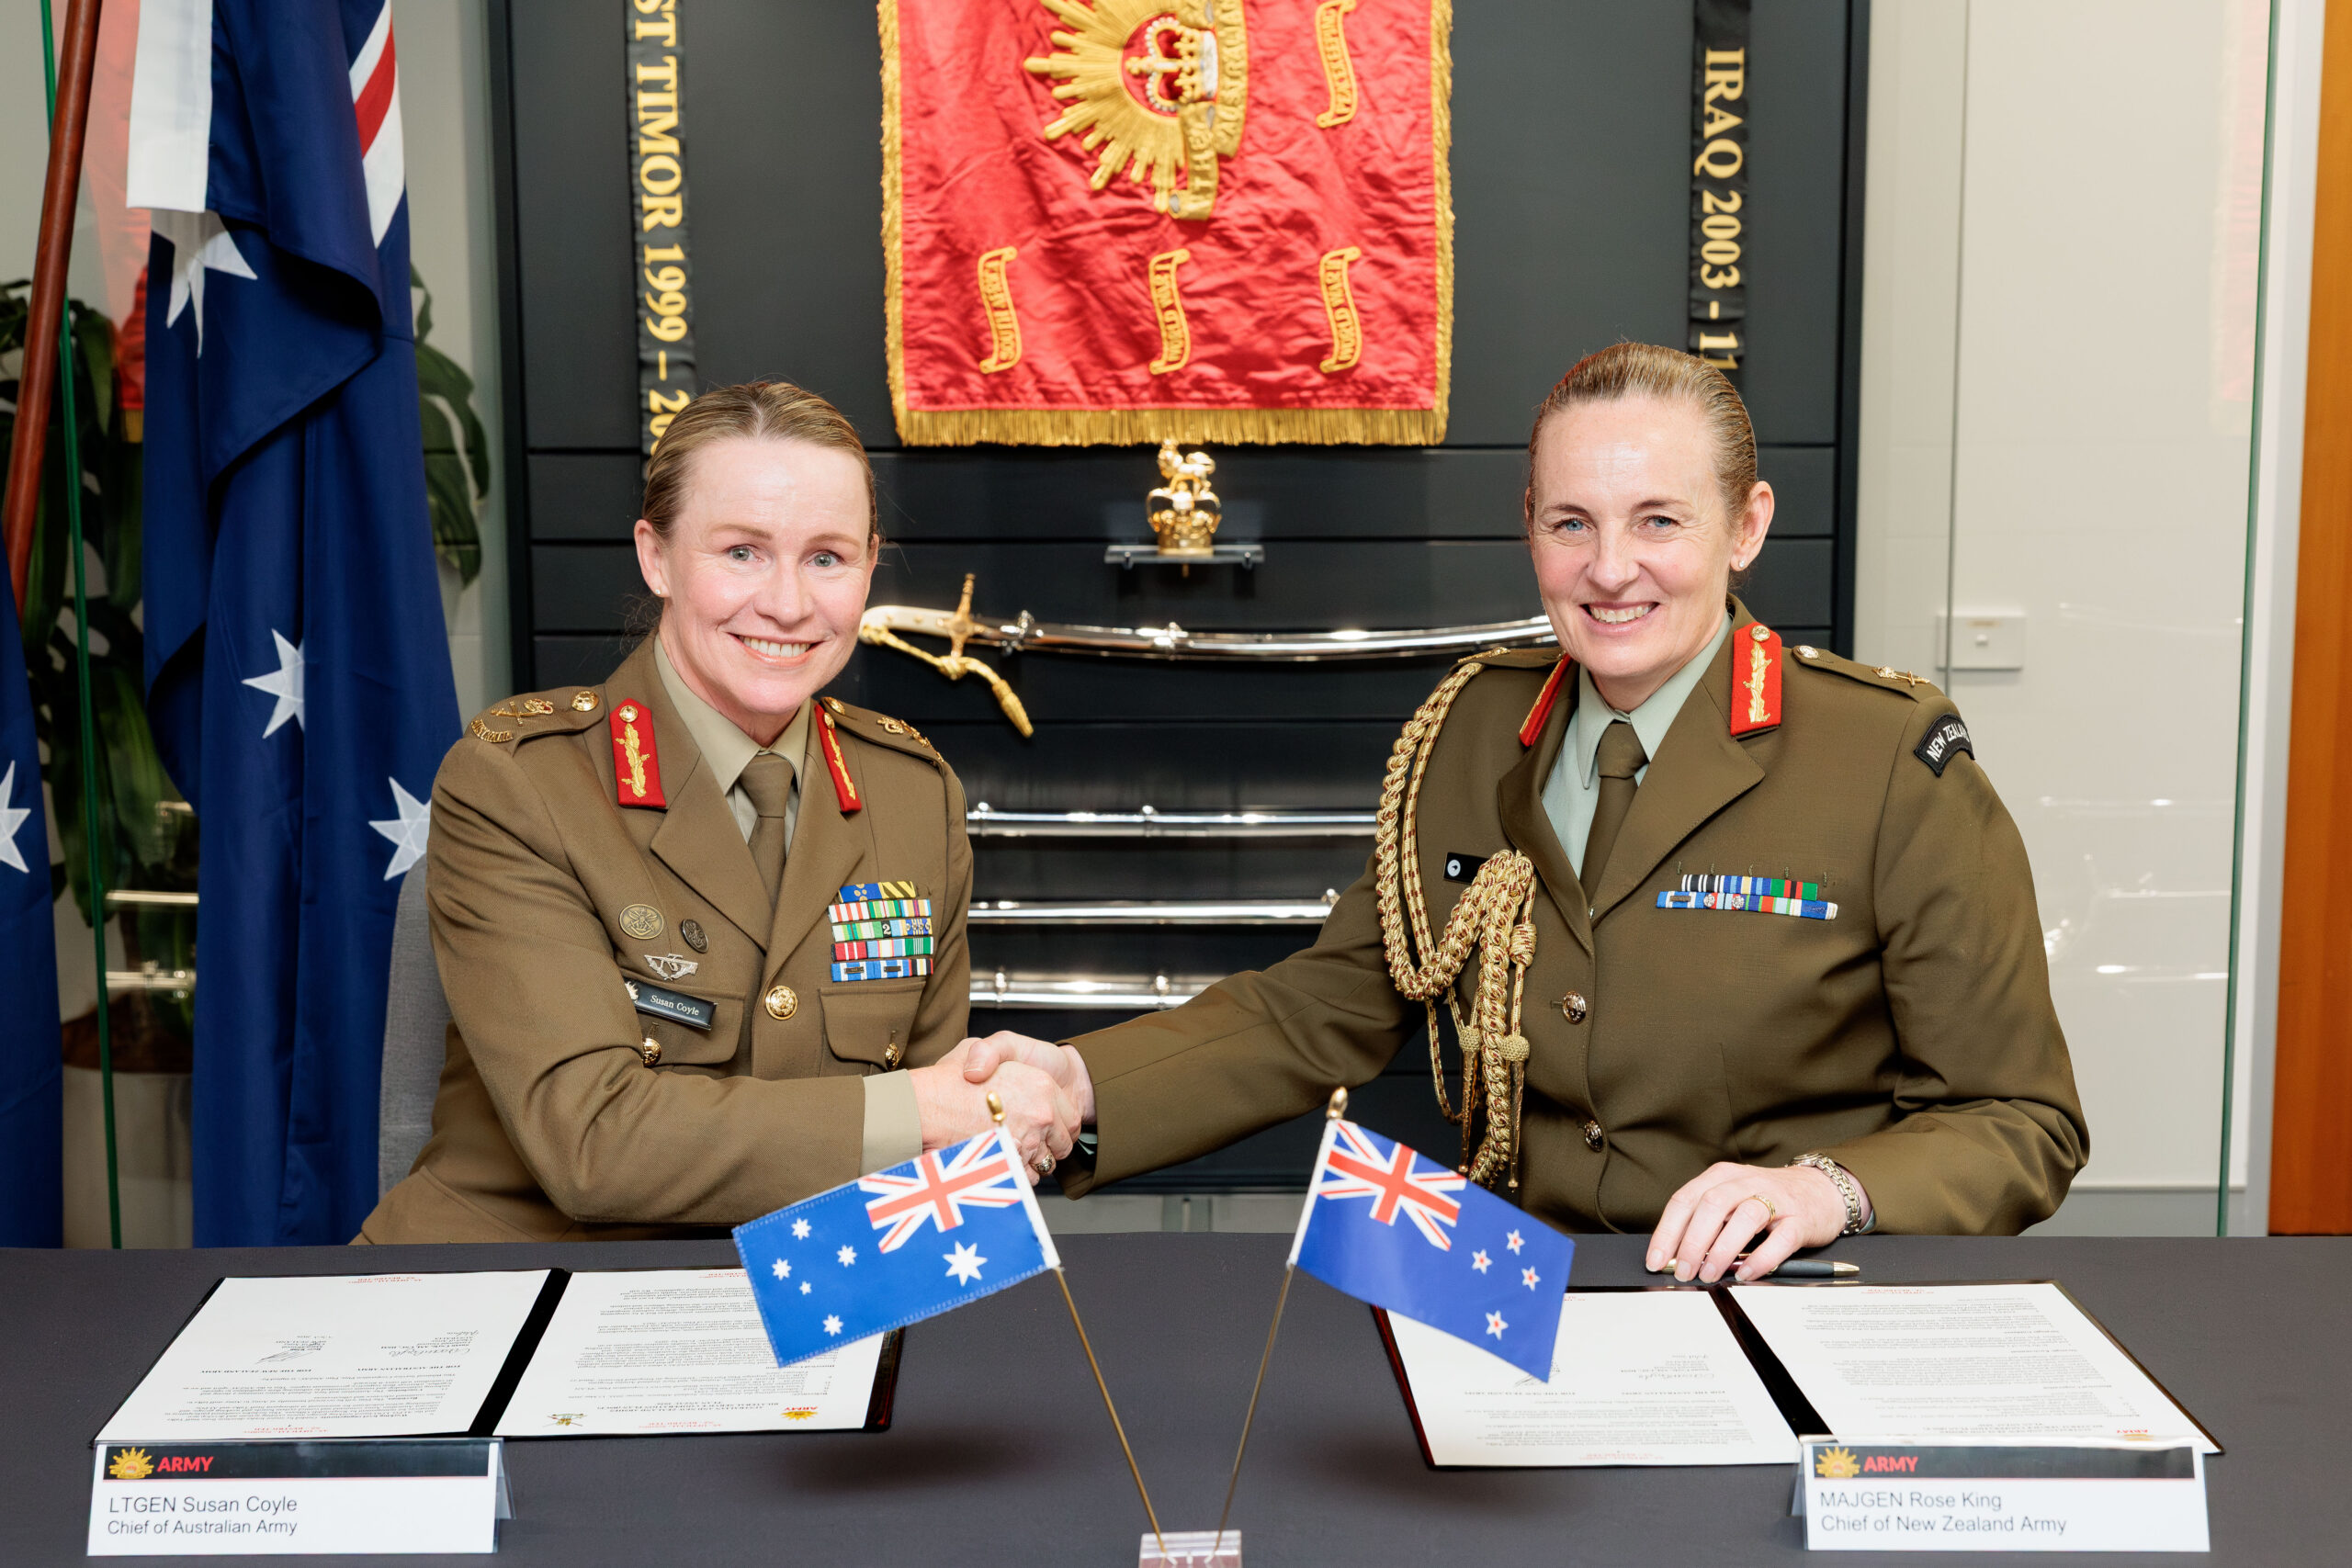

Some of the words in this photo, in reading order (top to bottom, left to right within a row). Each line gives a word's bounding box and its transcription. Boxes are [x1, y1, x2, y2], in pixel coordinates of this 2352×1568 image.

[1694, 46, 1745, 178] IRAQ
[637, 55, 683, 232] TIMOR
[1700, 189, 1742, 289] 2003
[644, 243, 688, 343] 1999
[1151, 272, 1174, 309] WAR
[1325, 271, 1346, 309] WAR
[1162, 308, 1185, 363] WORLD
[1333, 306, 1356, 362] WORLD
[1927, 731, 1948, 762] NEW
[882, 923, 892, 936] 2
[650, 995, 674, 1010] Susan
[676, 1002, 700, 1016] Coyle
[157, 1456, 214, 1472] ARMY
[1863, 1456, 1919, 1472] ARMY
[109, 1496, 176, 1513] LTGEN
[183, 1496, 240, 1513] Susan
[246, 1495, 298, 1516] Coyle
[1820, 1492, 1902, 1507] MAJGEN
[1910, 1492, 1955, 1507] Rose
[1962, 1493, 2002, 1511] King
[107, 1519, 150, 1535] Chief
[153, 1519, 170, 1534] of
[173, 1519, 251, 1534] Australian
[255, 1519, 298, 1537] Army
[1821, 1516, 1868, 1531] Chief
[1873, 1516, 1890, 1531] of
[1896, 1516, 1935, 1531] New
[1942, 1516, 2014, 1531] Zealand
[2020, 1516, 2067, 1535] Army
